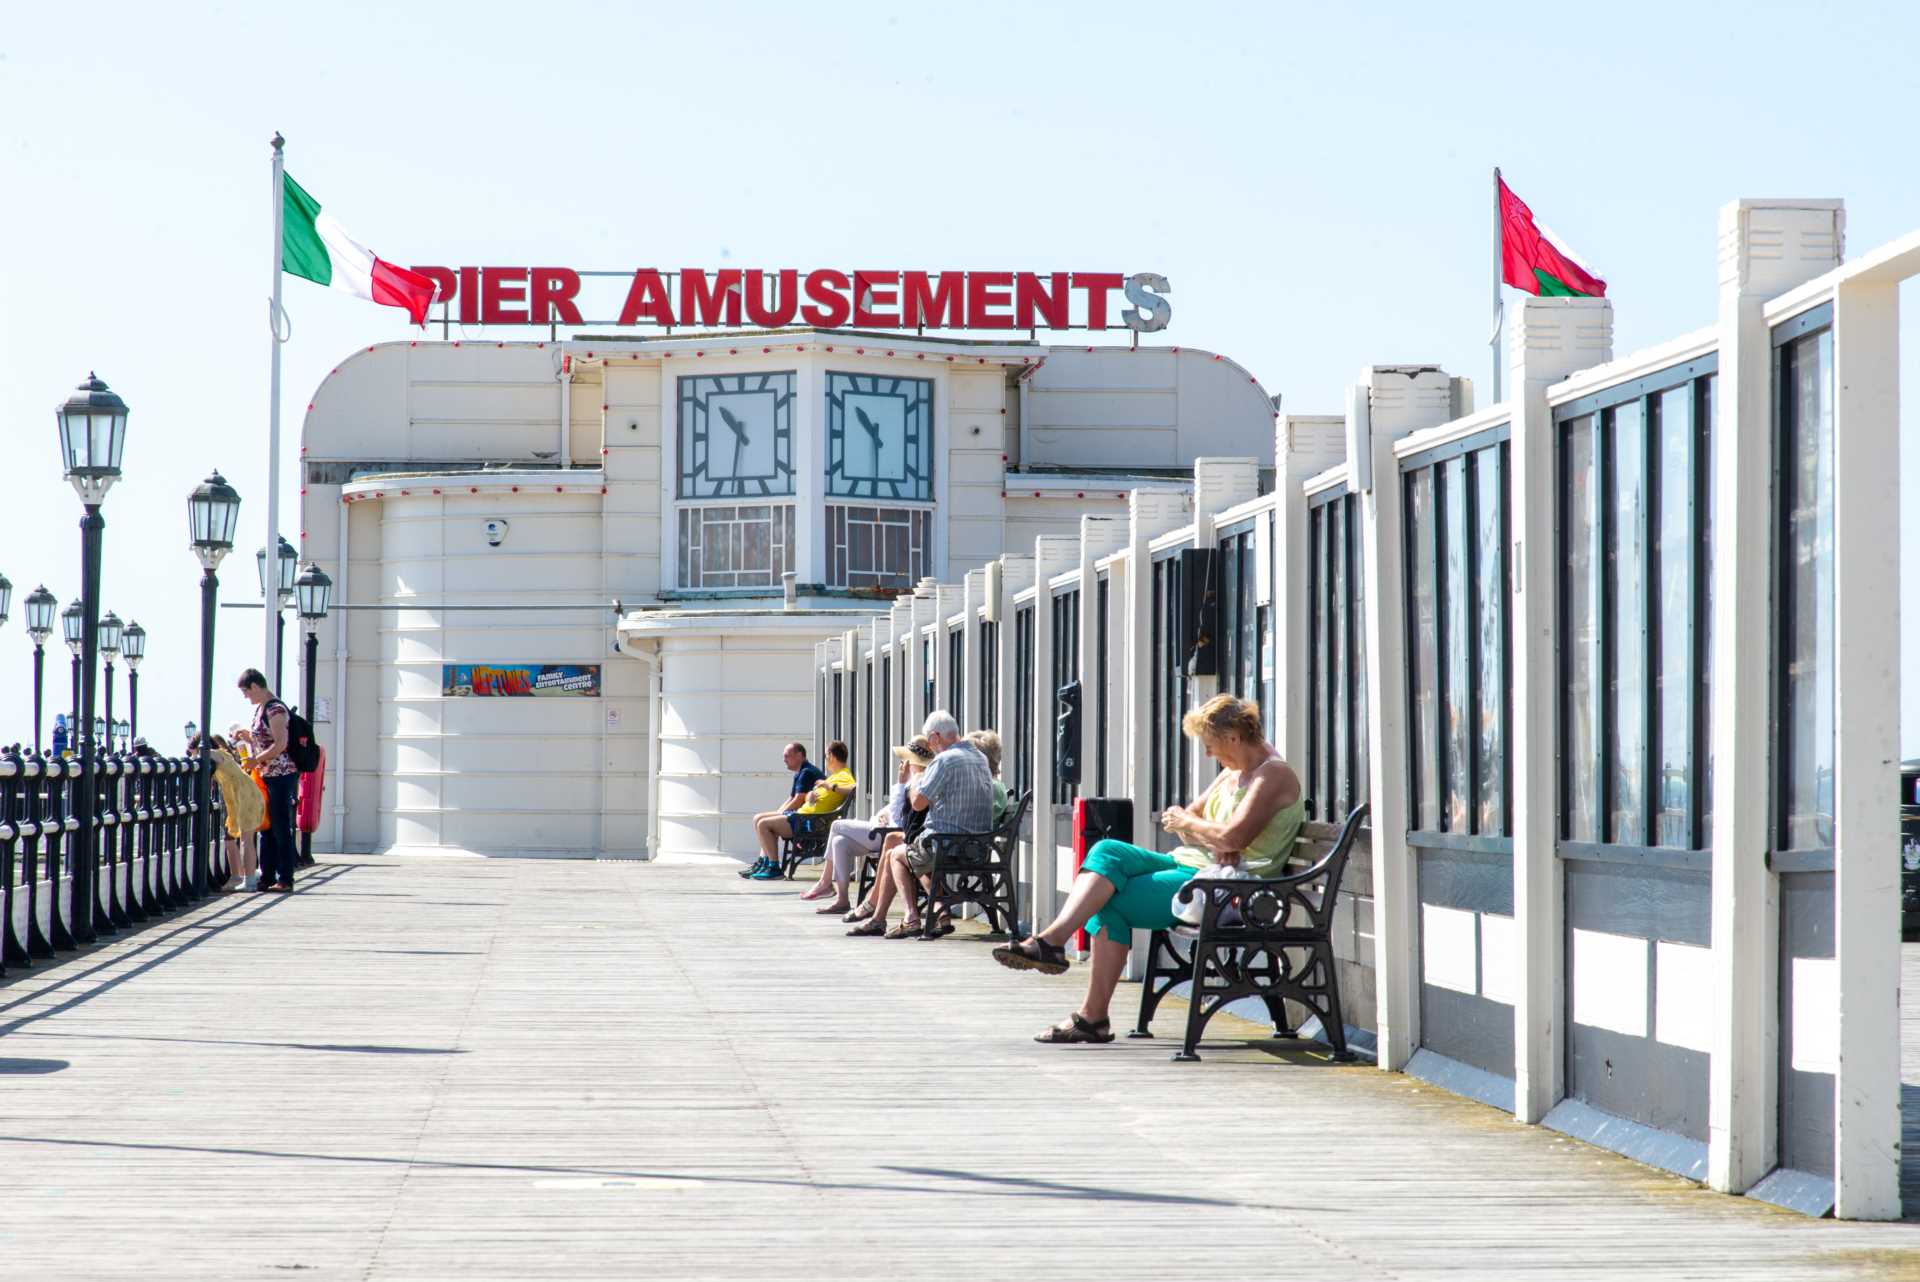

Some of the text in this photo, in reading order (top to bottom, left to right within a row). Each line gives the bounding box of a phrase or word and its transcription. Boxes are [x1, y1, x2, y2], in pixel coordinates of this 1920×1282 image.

[410, 266, 1172, 332] PIER AMUSEMENTS
[537, 672, 563, 681] FAMILY
